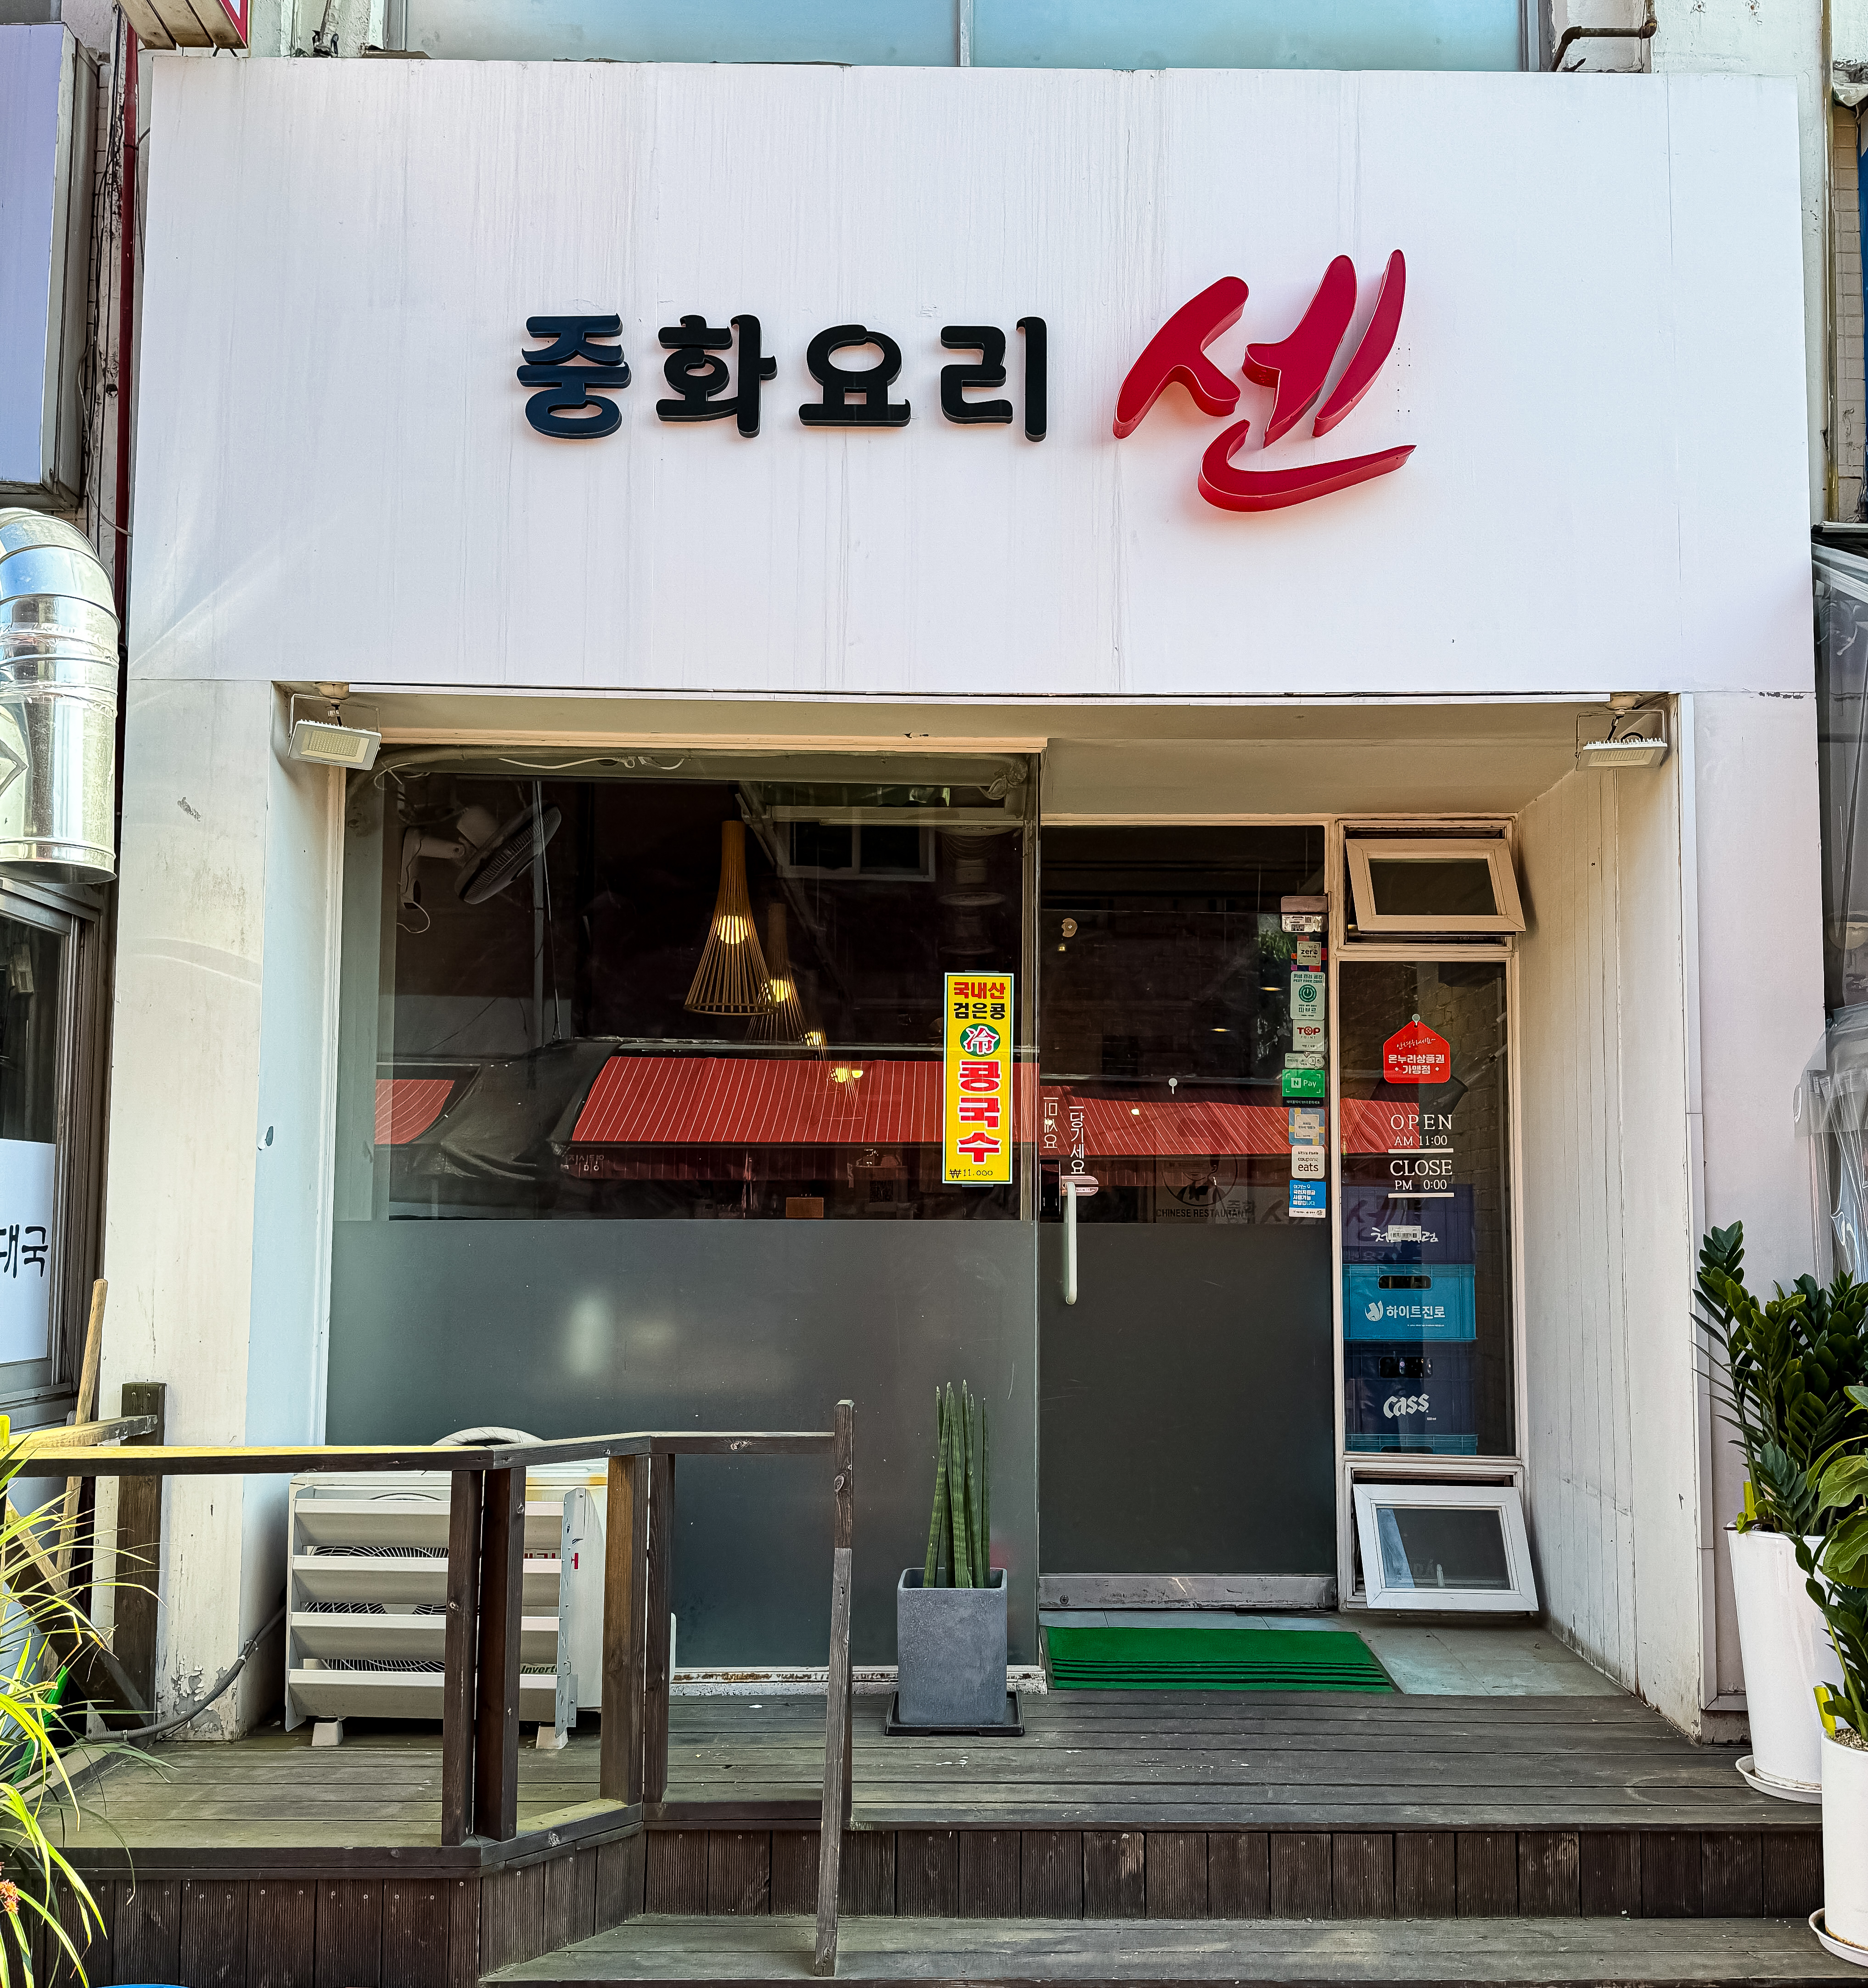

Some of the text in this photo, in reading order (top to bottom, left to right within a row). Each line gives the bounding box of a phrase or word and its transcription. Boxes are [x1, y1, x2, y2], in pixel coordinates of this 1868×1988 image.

[516, 248, 1416, 513] 중화요리 센
[954, 982, 1006, 1000] 국내산
[953, 1002, 1006, 1020] 검은콩
[1296, 1026, 1321, 1036] TOP
[960, 1025, 998, 1055] 冷
[1402, 1065, 1430, 1074] 가맹점
[1303, 1079, 1317, 1088] Pay
[957, 1059, 1002, 1165] 콩국수
[1390, 1114, 1453, 1130] OPEN
[1394, 1135, 1447, 1146] AM 11:00
[1298, 1162, 1319, 1172] eats
[1390, 1160, 1453, 1176] CLOSE
[1395, 1179, 1447, 1190] PM 0:00
[1156, 1208, 1191, 1217] CHINESE
[1386, 1305, 1446, 1319] 하이트진로
[520, 1665, 557, 1674] Invert
